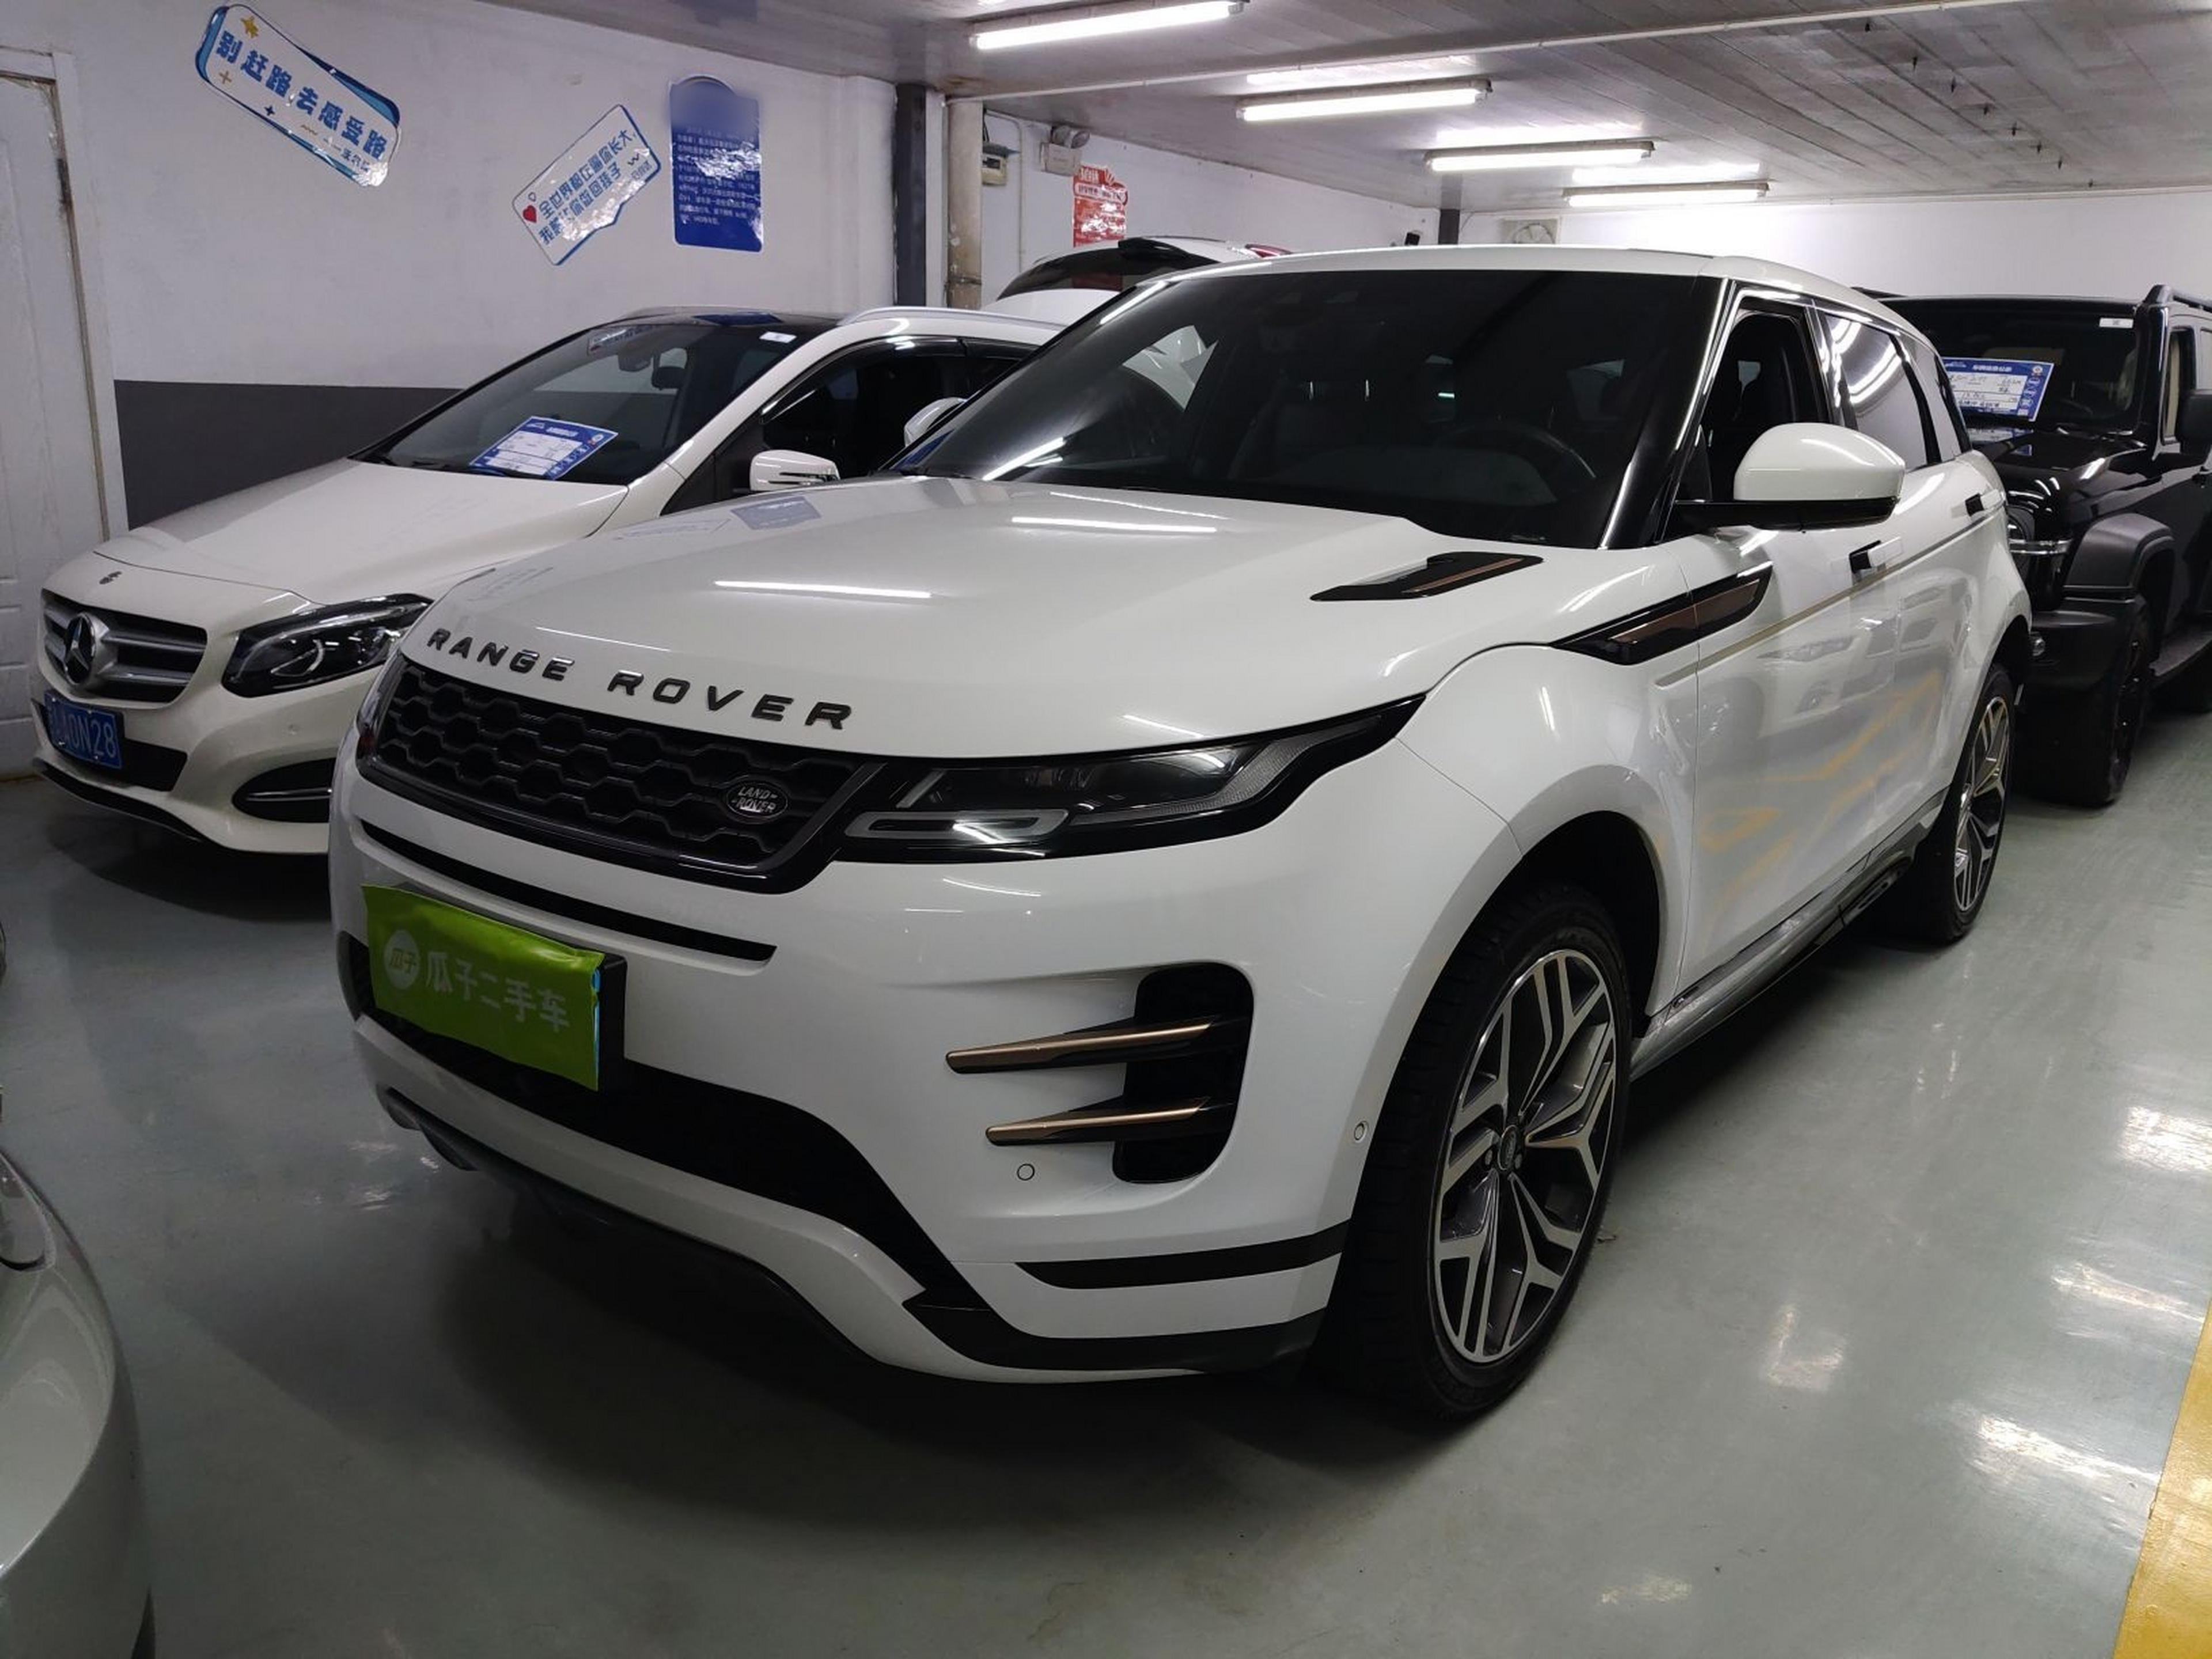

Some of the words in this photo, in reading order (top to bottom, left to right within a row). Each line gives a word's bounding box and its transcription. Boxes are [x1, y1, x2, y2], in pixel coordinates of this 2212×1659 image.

[427, 627, 575, 681] RANGE
[607, 669, 853, 730] ROVER
[426, 950, 571, 1033] 瓜子二手车
